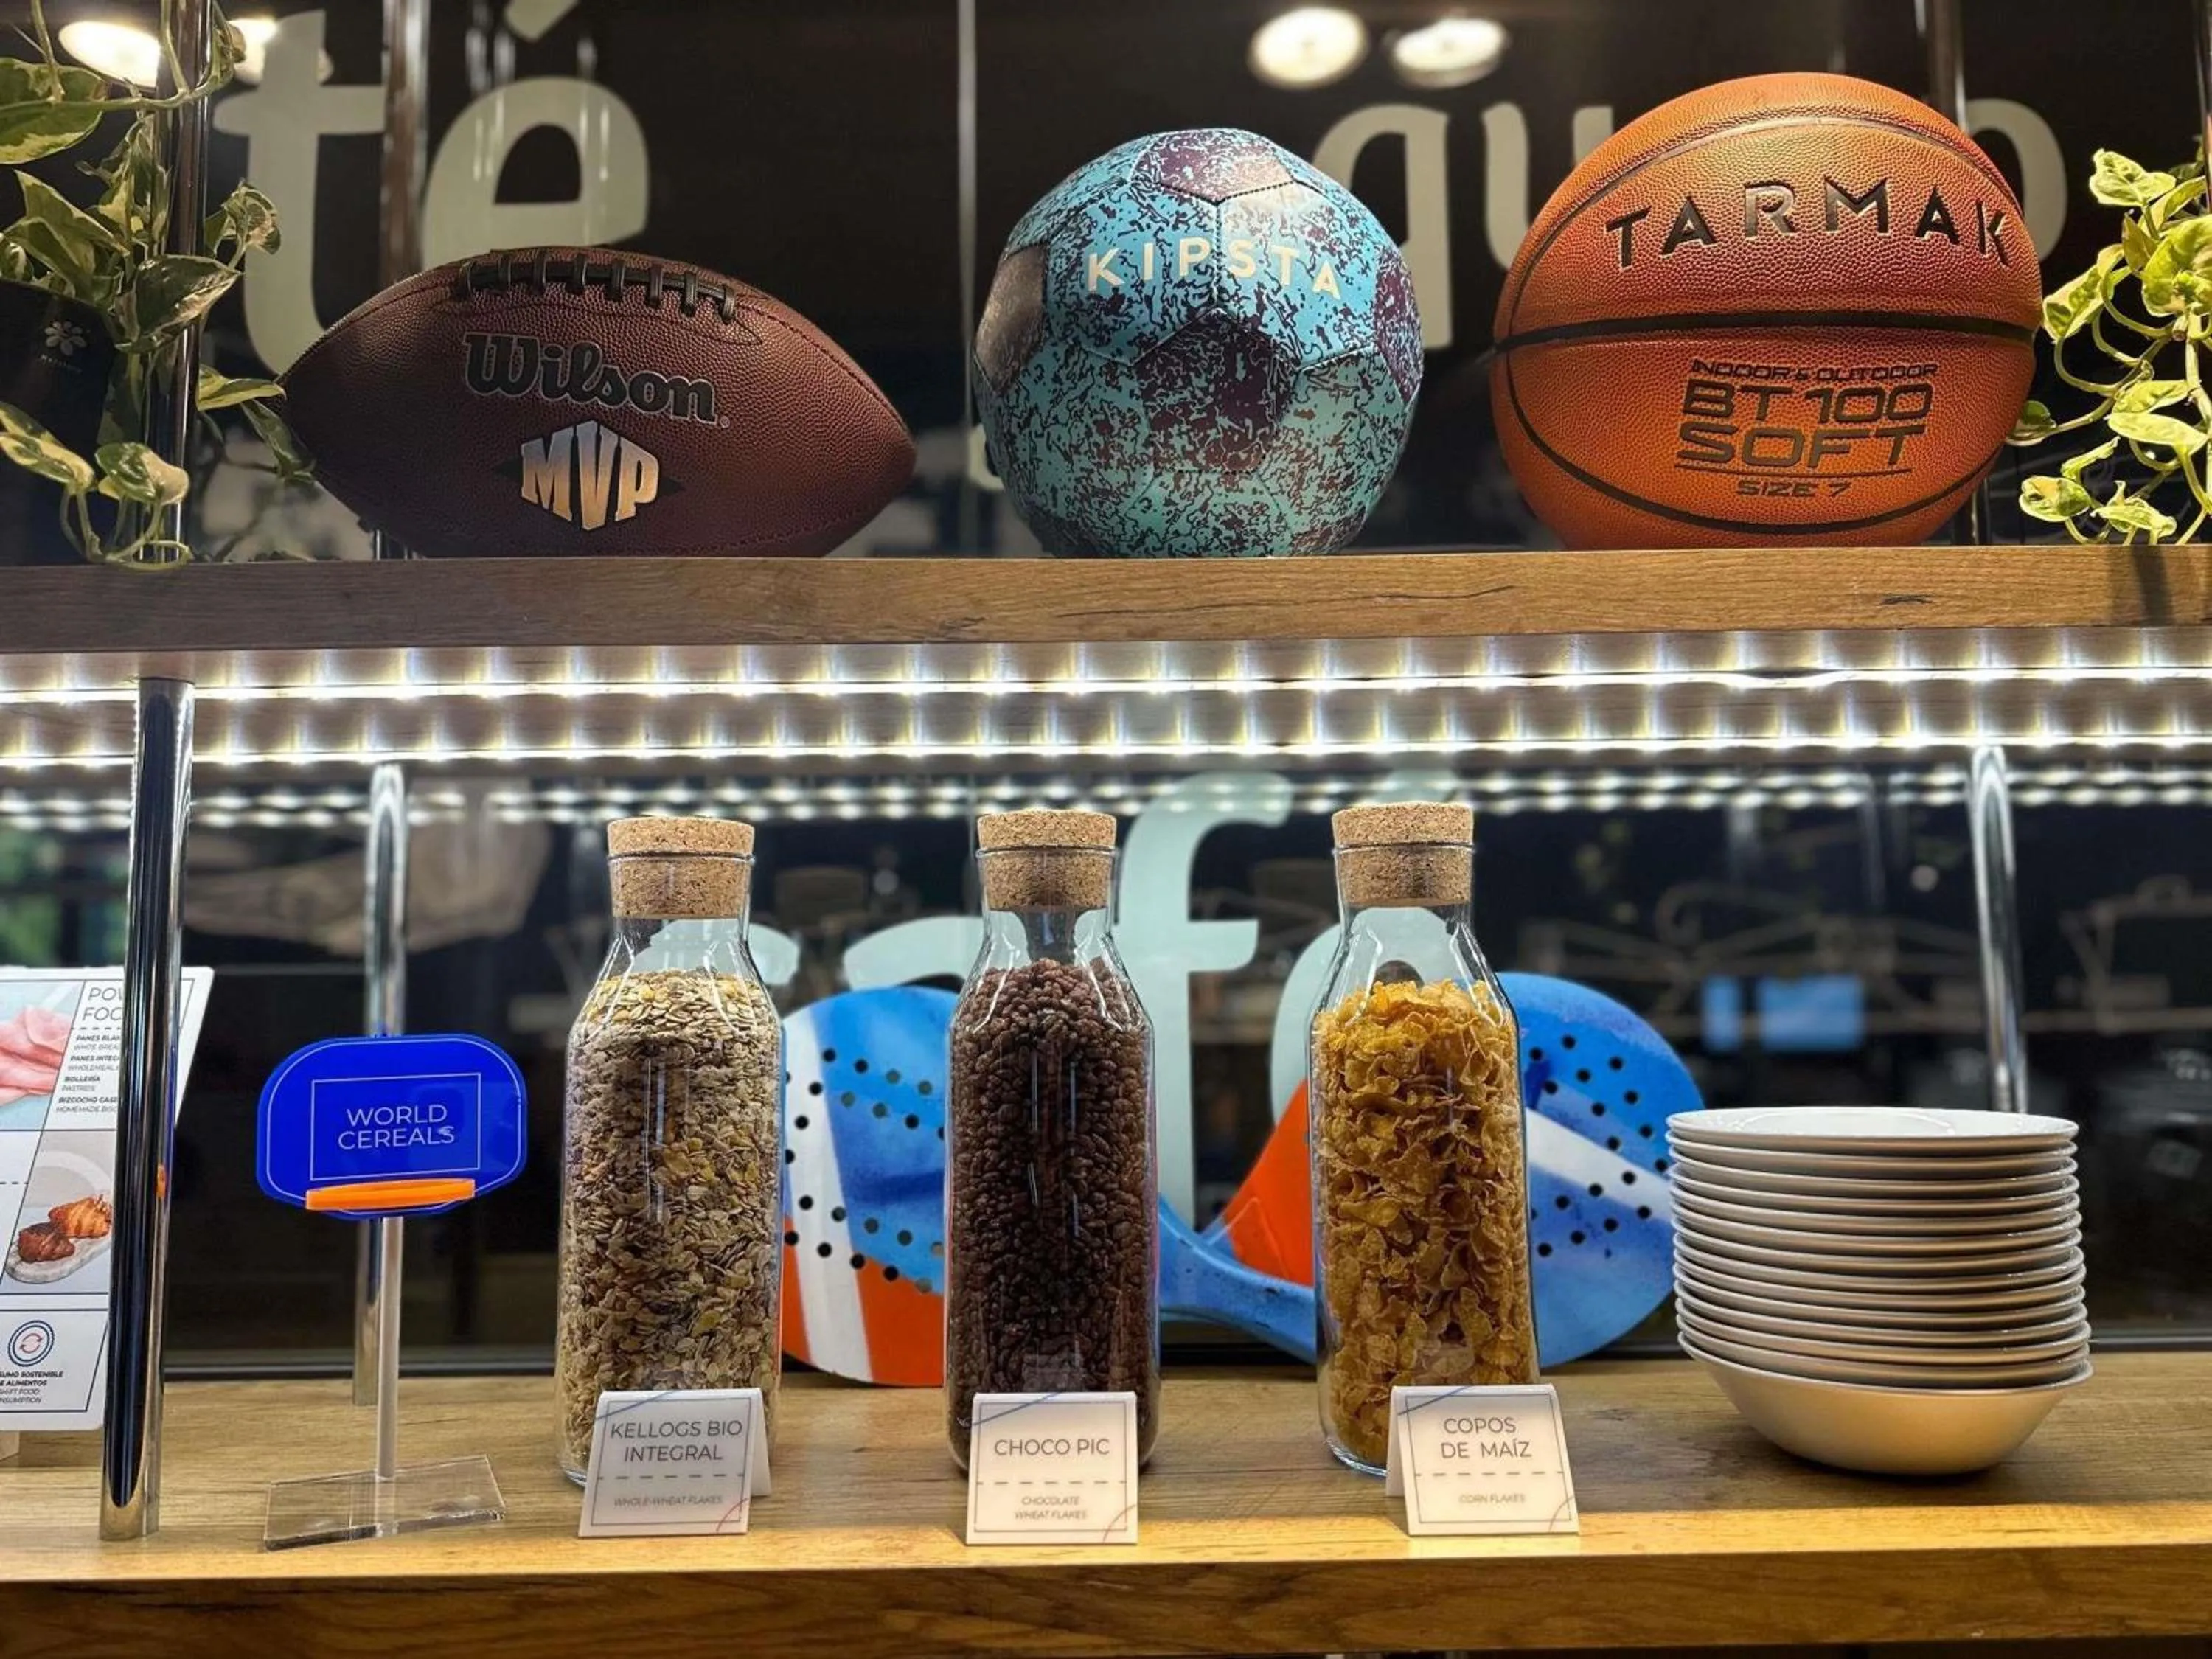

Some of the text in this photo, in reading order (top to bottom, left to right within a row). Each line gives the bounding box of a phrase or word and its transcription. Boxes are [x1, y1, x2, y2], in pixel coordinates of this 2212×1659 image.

[1606, 177, 2008, 266] TARMAK
[1088, 237, 1340, 299] KIPSTA
[463, 332, 718, 425] Wilson
[1693, 359, 1790, 380] INDOOR
[1816, 364, 1939, 381] OUTDOOR
[1682, 378, 1935, 424] BT 100
[1677, 421, 1927, 468] SOFT
[521, 420, 659, 531] MVP
[1736, 480, 1851, 497] SIZE 7
[346, 1104, 448, 1127] WORLD
[338, 1125, 456, 1150] CEREALS
[611, 1420, 743, 1439] KELLOGS BIO
[1443, 1417, 1517, 1433] COPOS
[624, 1444, 723, 1462] INTEGRAL
[995, 1439, 1110, 1455] CHOCO PIC
[1441, 1438, 1532, 1458] DE MAÍZ
[1021, 1496, 1080, 1506] CHOCOLATE
[1015, 1511, 1049, 1520] WHEAT
